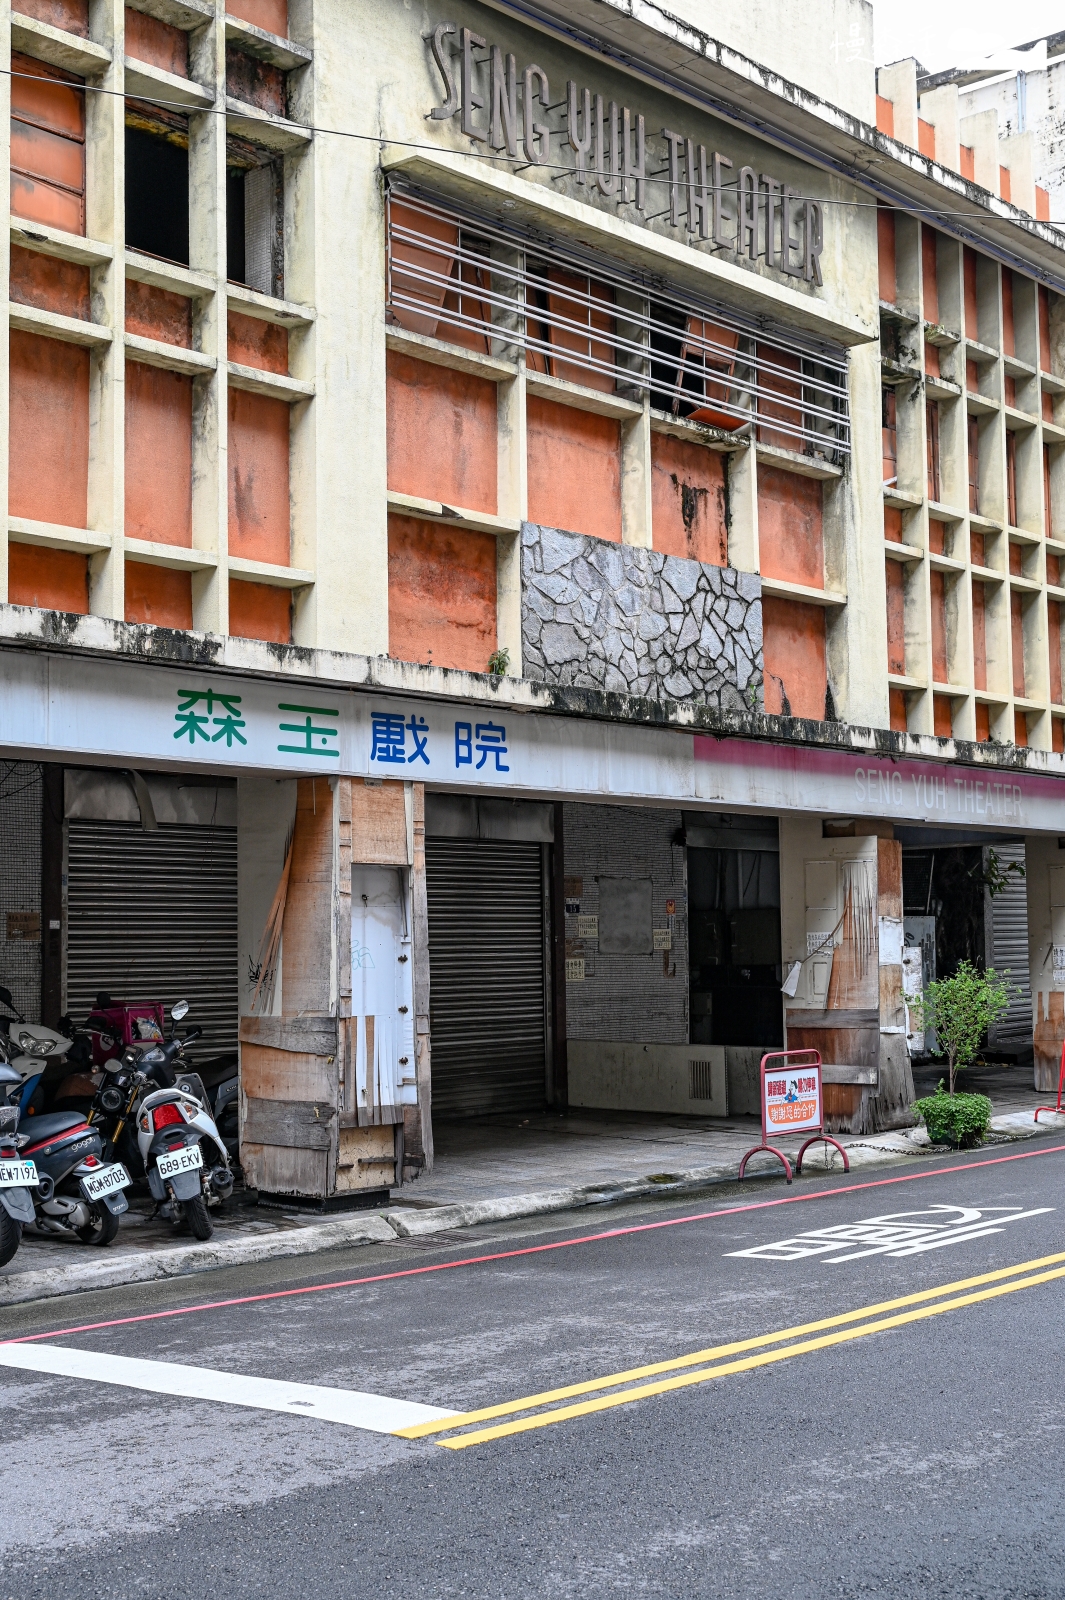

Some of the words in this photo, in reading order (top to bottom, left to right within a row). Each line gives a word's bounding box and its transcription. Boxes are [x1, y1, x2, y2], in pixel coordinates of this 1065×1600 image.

[430, 21, 550, 164] SENG
[566, 80, 645, 211] YUH
[660, 128, 824, 288] THEATER
[854, 767, 902, 806] SENG
[911, 773, 946, 810] YUH
[954, 778, 1024, 818] THEATER
[771, 1103, 815, 1122] 謝謝您的合作
[159, 1152, 200, 1175] 689-EKV
[86, 1169, 126, 1194] MGM-8703
